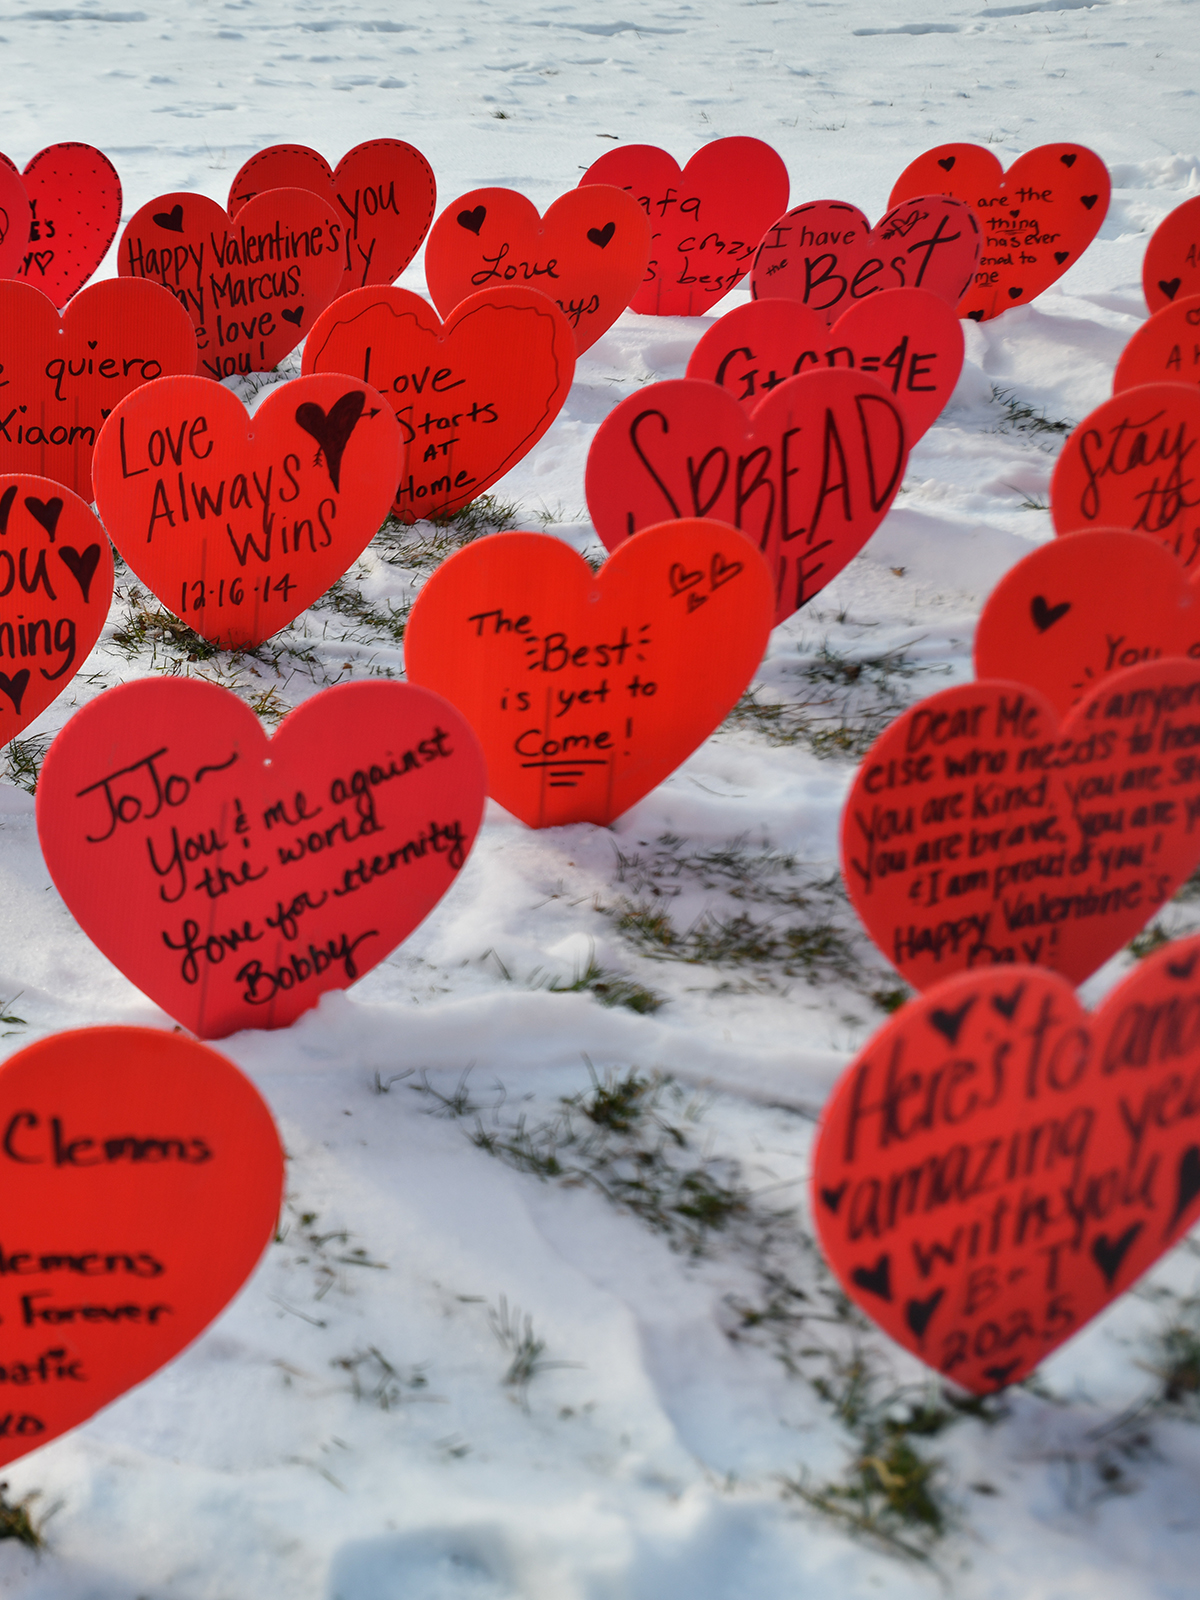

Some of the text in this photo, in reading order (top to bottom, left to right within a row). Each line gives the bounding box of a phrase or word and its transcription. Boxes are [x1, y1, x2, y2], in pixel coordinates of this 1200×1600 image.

[337, 180, 400, 240] you
[977, 187, 1053, 207] are the
[986, 216, 1040, 236] thing
[128, 237, 204, 292] Happy
[210, 220, 341, 268] Valentine's
[471, 242, 560, 285] Love
[765, 226, 856, 249] I have
[765, 258, 789, 276] the
[1018, 251, 1038, 265] to
[1024, 231, 1061, 246] ever
[676, 256, 747, 292] best
[974, 270, 999, 284] me
[217, 311, 276, 347] love
[45, 341, 162, 401] quiero
[364, 347, 466, 395] Love
[120, 416, 213, 479] Love
[1080, 410, 1197, 520] Stay
[147, 453, 301, 543] Always
[396, 470, 477, 504] Home
[227, 498, 337, 567] Wins
[468, 609, 532, 637] The
[541, 626, 632, 673] Best
[500, 675, 658, 718] is yet to
[906, 695, 1042, 754] Dear Me
[863, 755, 934, 795] else
[945, 749, 1008, 779] who
[1016, 731, 1118, 772] needs
[147, 726, 454, 902] You me against
[920, 792, 964, 825] are
[1120, 765, 1162, 791] are
[195, 803, 384, 899] the world
[334, 820, 468, 897] eternity
[913, 833, 963, 867] are
[1130, 801, 1176, 828] are
[945, 868, 990, 898] am
[992, 851, 1066, 901] proud
[235, 929, 380, 1005] Bobby
[894, 912, 994, 964] Happy
[1022, 996, 1092, 1099] to
[847, 1106, 1096, 1243] amazing
[912, 1152, 1159, 1279] with you
[20, 1289, 173, 1328] Forever
[941, 1292, 1075, 1372] 2025
